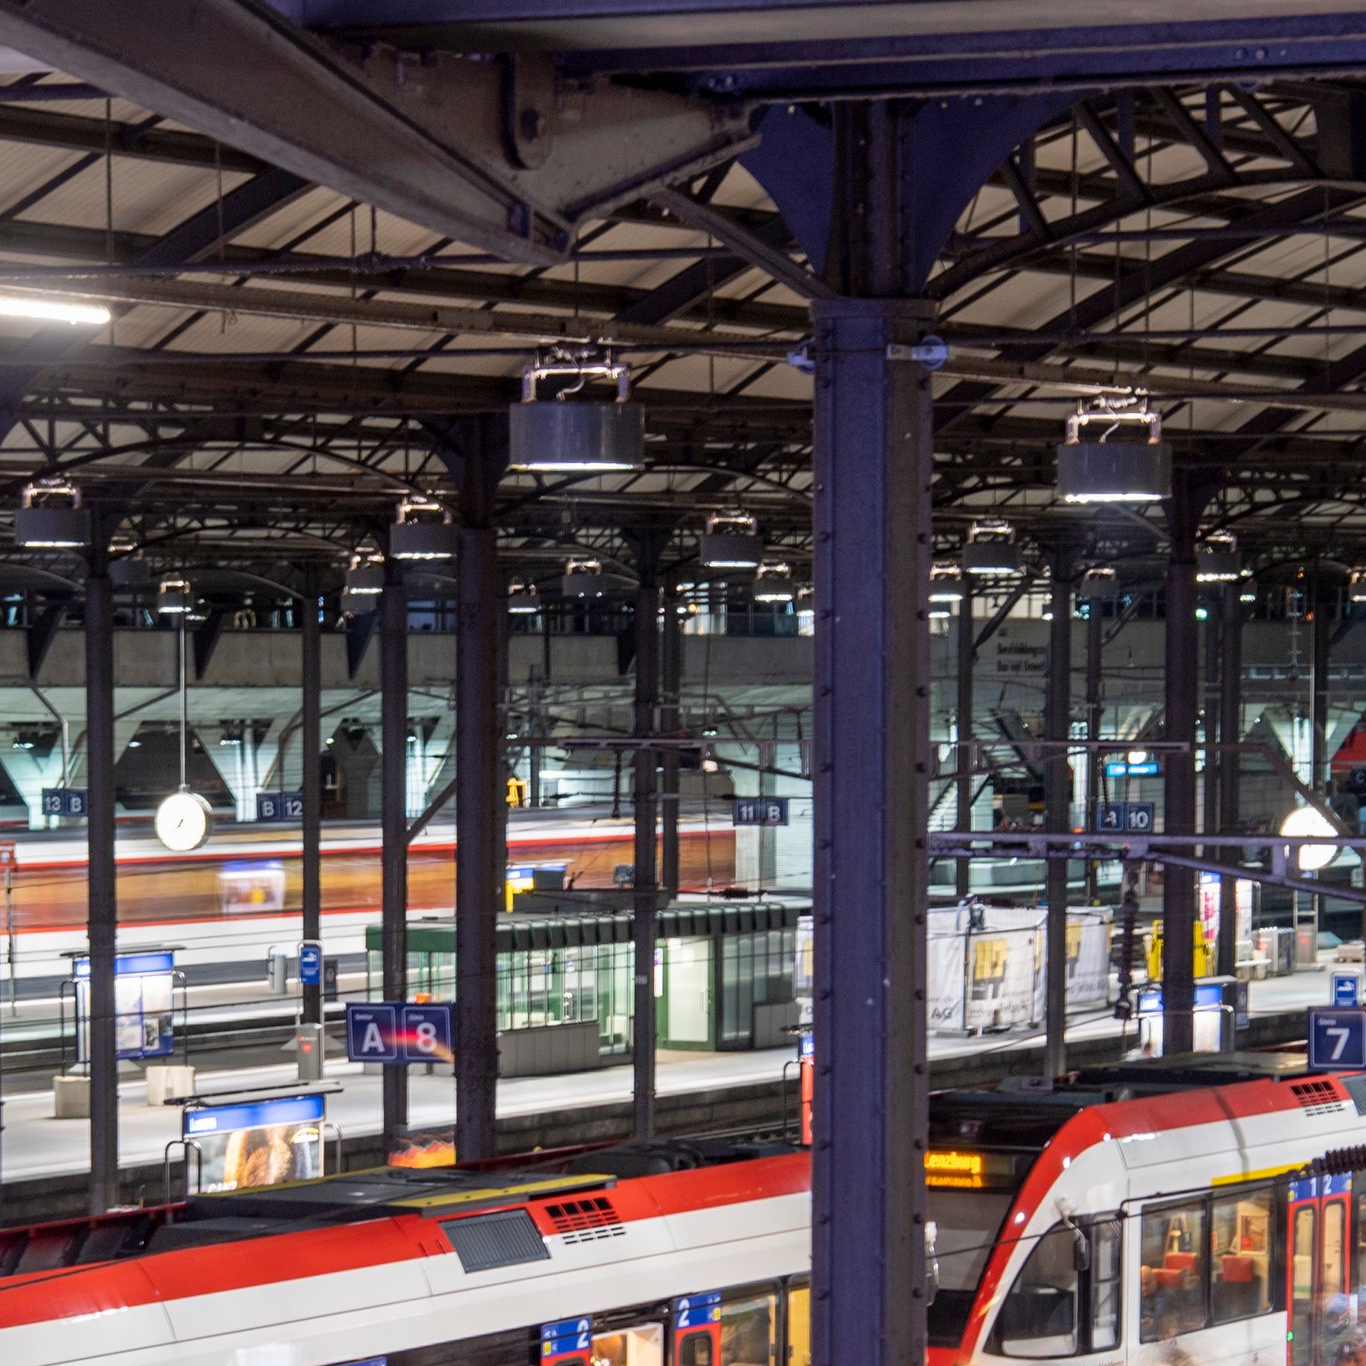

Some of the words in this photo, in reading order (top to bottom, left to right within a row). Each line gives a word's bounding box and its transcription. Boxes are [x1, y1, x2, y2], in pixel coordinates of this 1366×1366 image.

[45, 796, 61, 811] 13
[70, 797, 82, 812] B
[262, 801, 275, 816] B
[286, 801, 303, 816] 12
[740, 805, 754, 820] 11
[768, 805, 780, 821] B
[1129, 811, 1148, 828] 10
[361, 1022, 385, 1053] A
[416, 1022, 437, 1053] 8
[1326, 1028, 1350, 1060] 7
[1309, 1178, 1317, 1197] 1
[1323, 1175, 1332, 1196] 2
[678, 1299, 690, 1328] 2
[577, 1319, 589, 1349] 2
